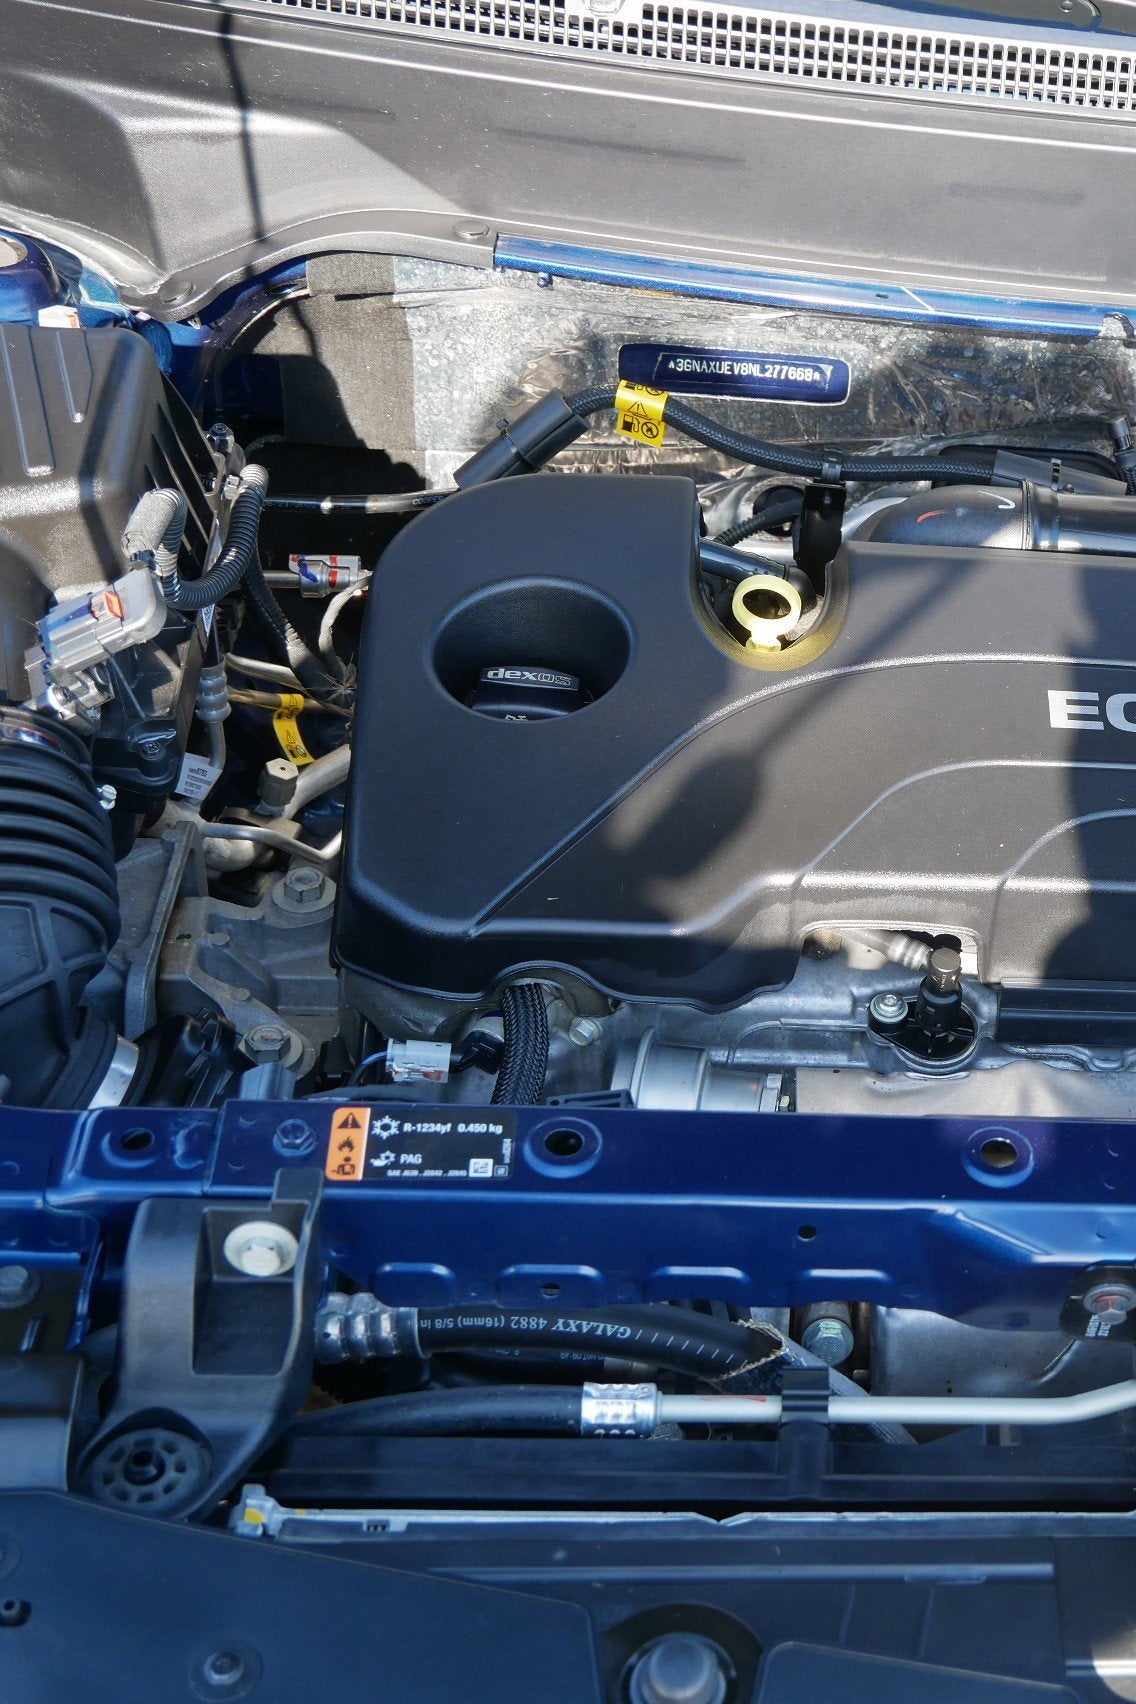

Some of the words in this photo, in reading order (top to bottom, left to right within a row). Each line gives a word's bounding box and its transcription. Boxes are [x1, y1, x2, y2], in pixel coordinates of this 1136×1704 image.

[487, 668, 571, 686] dexos
[403, 1122, 451, 1135] R-1234yf
[457, 1123, 487, 1133] 0.450
[488, 1124, 503, 1136] kg
[400, 1153, 422, 1165] PAG
[420, 1319, 432, 1329] in
[435, 1320, 454, 1329] 5/8
[457, 1315, 505, 1329] (16mm)
[511, 1316, 547, 1330] 4882
[551, 1318, 632, 1339] GALAXY
